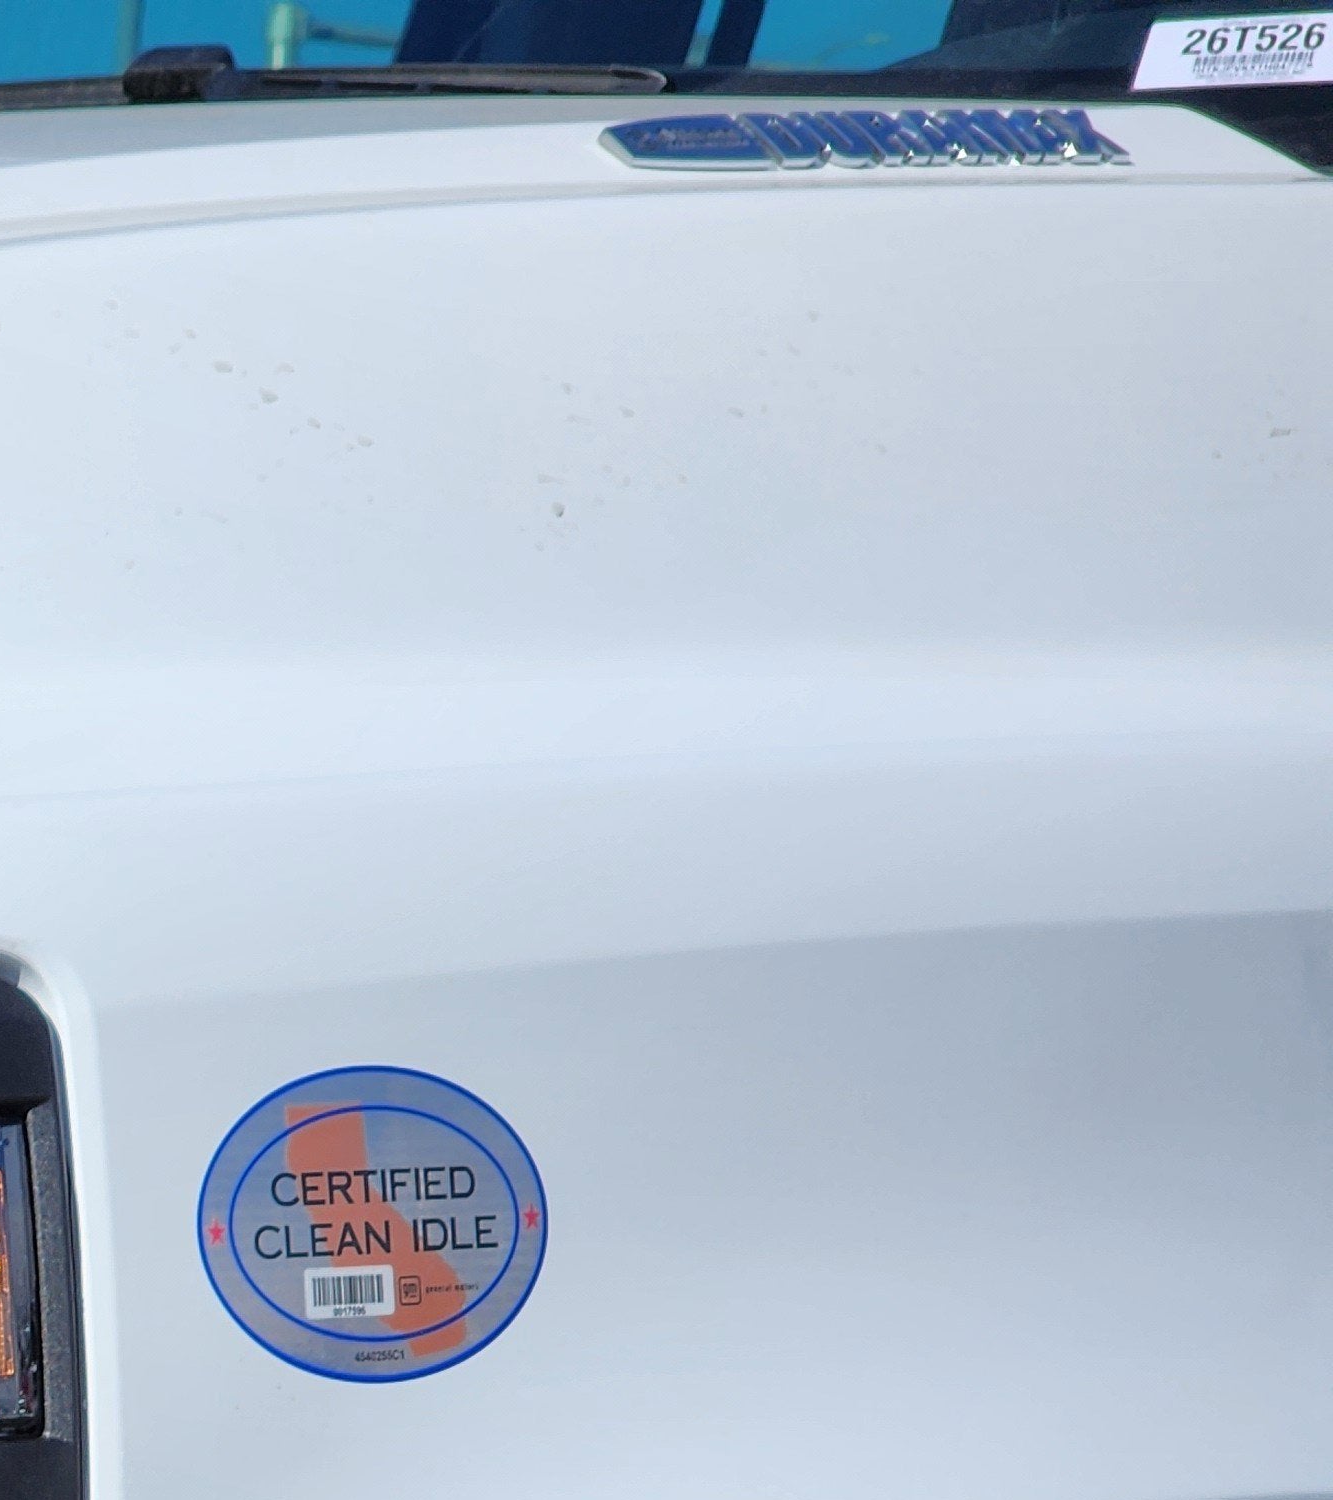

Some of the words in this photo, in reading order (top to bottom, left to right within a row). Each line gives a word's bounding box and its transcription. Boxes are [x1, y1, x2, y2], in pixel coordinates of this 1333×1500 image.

[1181, 22, 1327, 55] 26T526
[270, 1165, 476, 1207] CERTIFIED
[253, 1220, 391, 1259] CLEAN
[413, 1214, 499, 1252] IDLE
